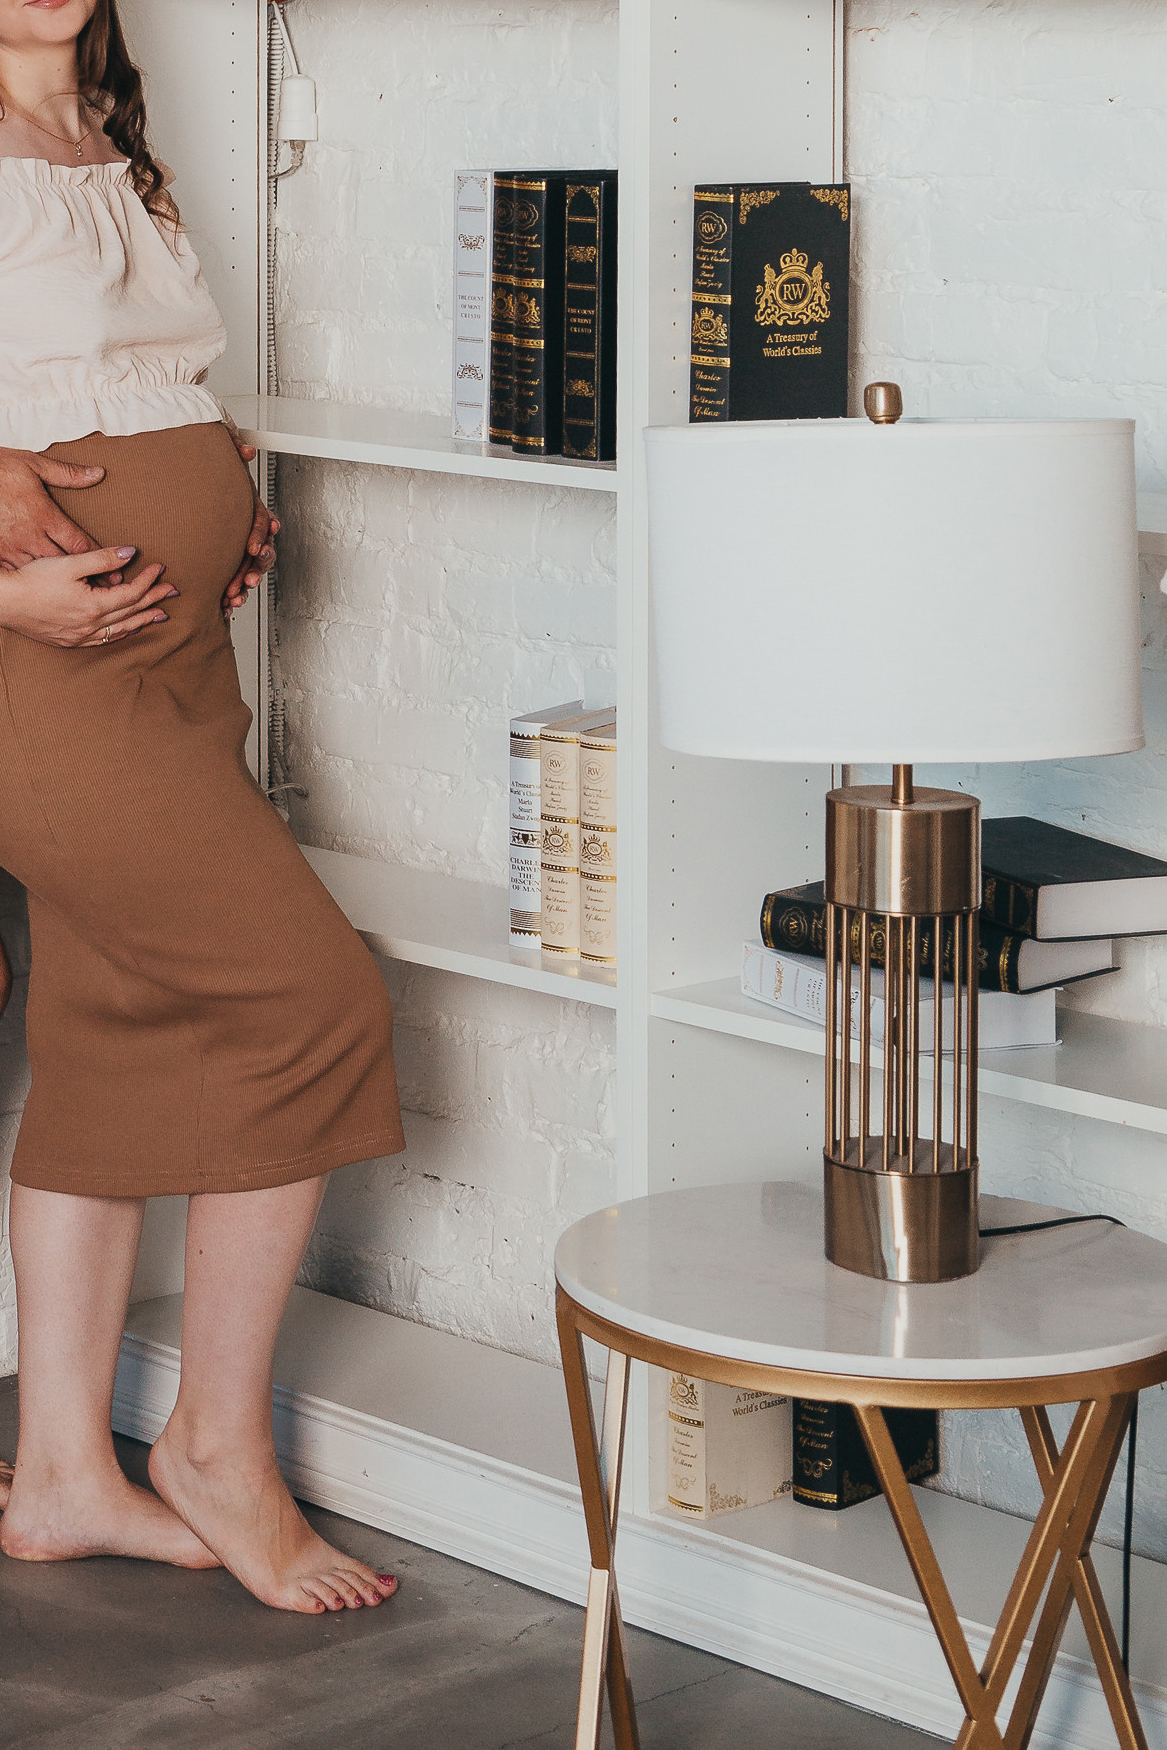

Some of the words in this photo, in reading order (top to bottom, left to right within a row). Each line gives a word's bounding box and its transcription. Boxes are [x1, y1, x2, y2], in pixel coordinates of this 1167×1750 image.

[701, 221, 716, 233] RW
[783, 283, 805, 302] RW
[767, 334, 774, 343] A
[774, 332, 807, 345] Treasury
[809, 331, 818, 341] of
[763, 347, 792, 357] World's
[792, 345, 822, 356] Classics
[549, 758, 562, 769] RW
[587, 766, 600, 776] RW
[735, 1395, 741, 1403] A
[732, 1403, 758, 1416] World's
[759, 1397, 787, 1410] Classics
